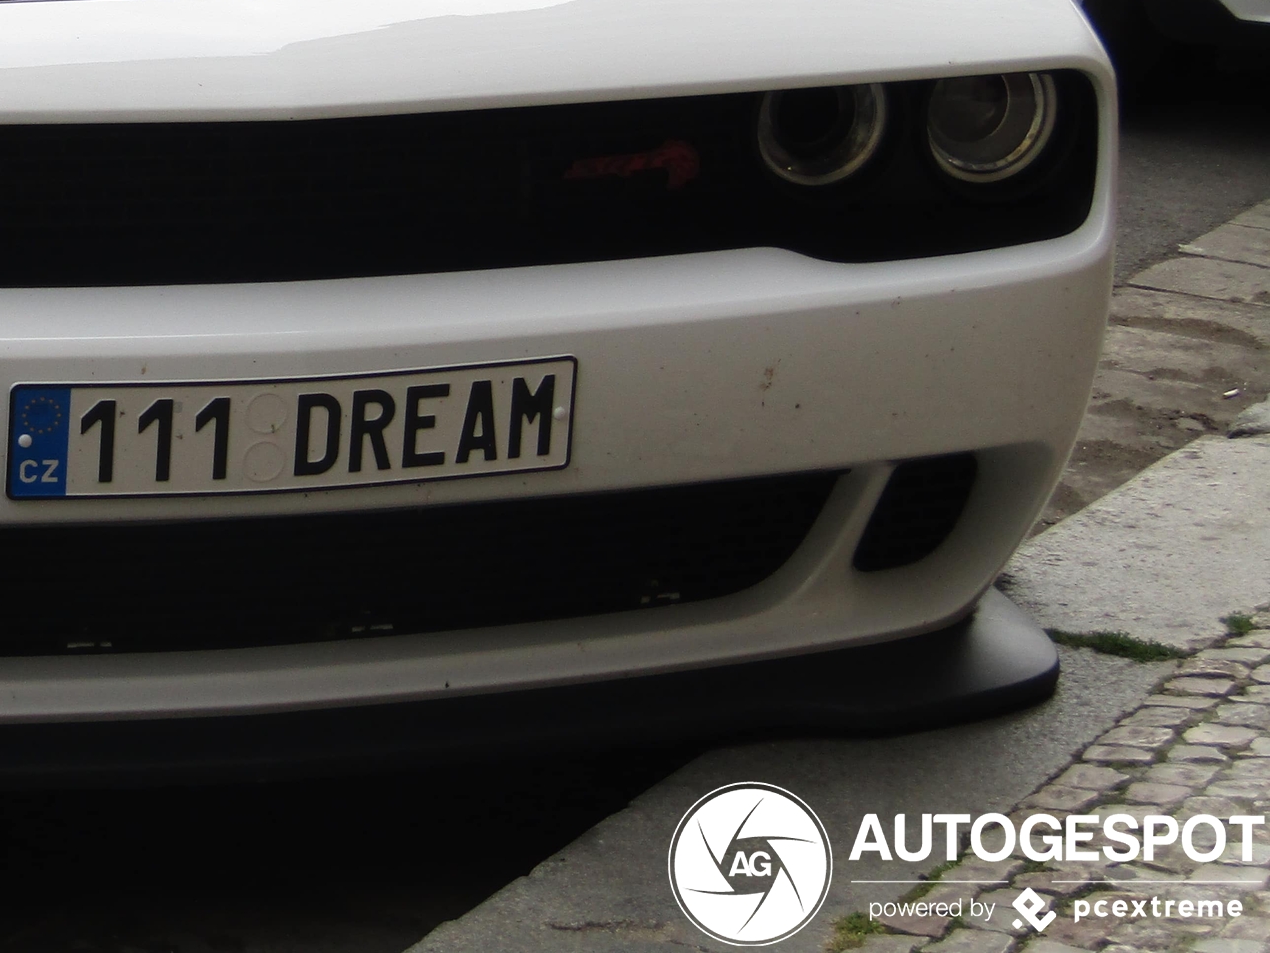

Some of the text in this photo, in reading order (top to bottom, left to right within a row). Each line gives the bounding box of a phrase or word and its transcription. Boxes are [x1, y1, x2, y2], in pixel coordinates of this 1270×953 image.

[79, 374, 557, 484] 111 DREAM
[18, 458, 60, 484] CZ
